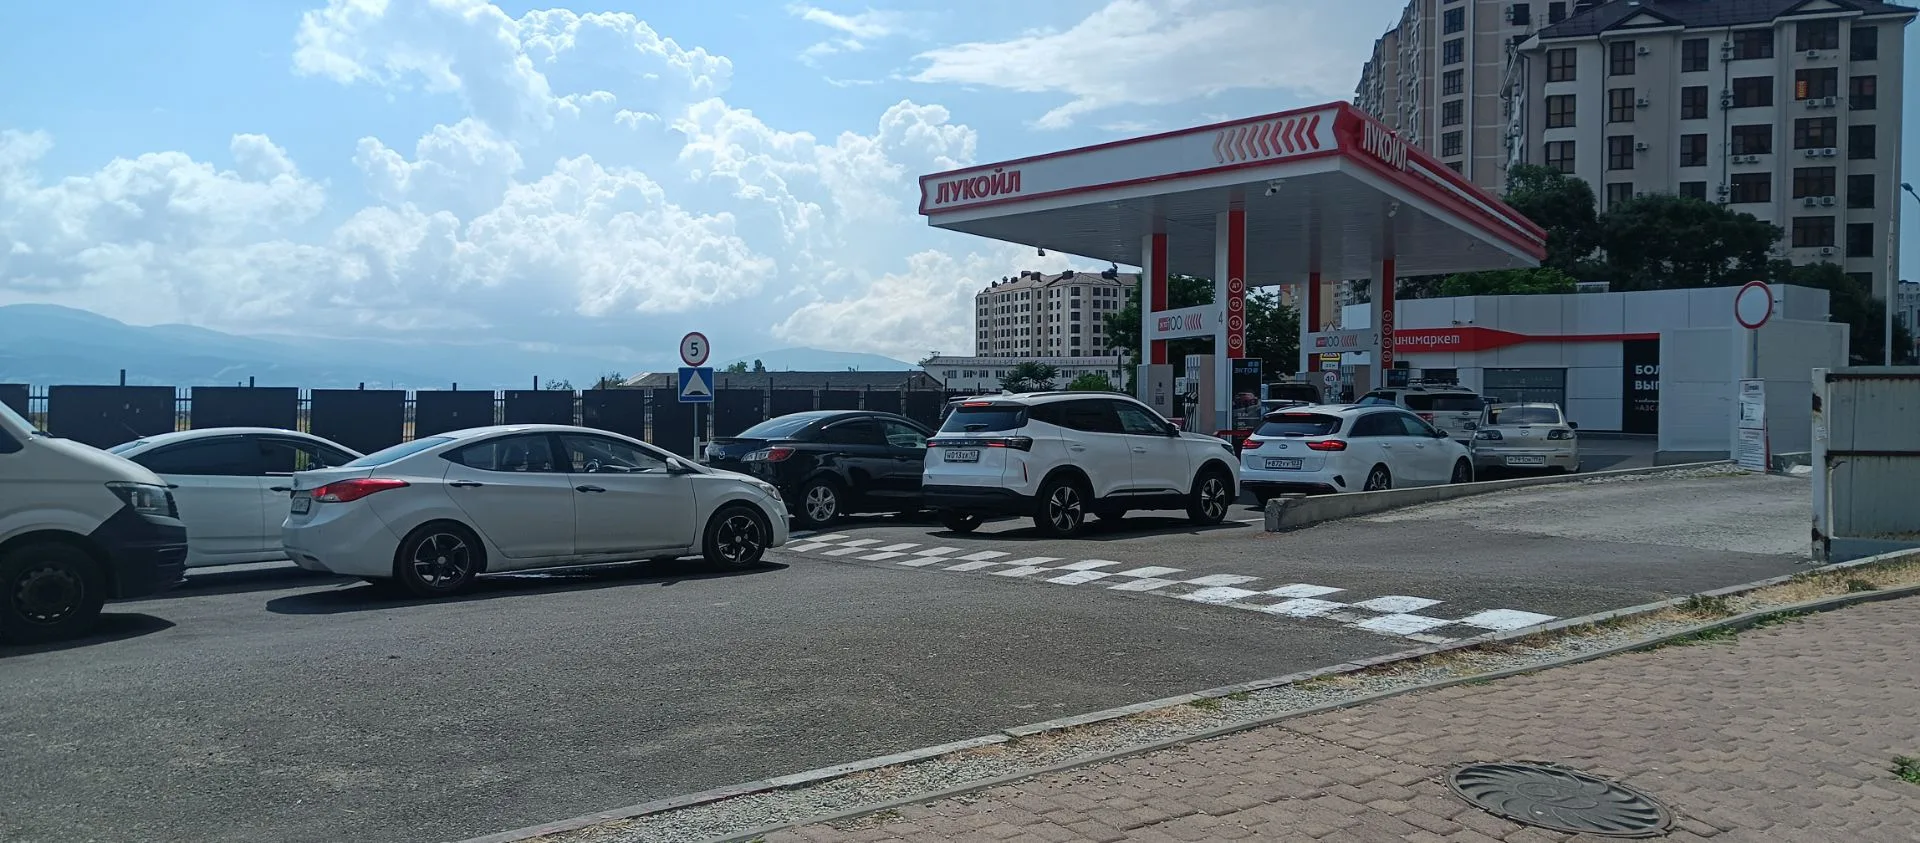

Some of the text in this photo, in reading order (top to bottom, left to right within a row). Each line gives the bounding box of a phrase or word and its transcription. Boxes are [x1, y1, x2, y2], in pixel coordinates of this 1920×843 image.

[1362, 119, 1407, 172] ЛУКОЙЛ
[935, 167, 1021, 204] ЛУКОЙЛ
[1218, 311, 1224, 325] 4
[1373, 333, 1379, 345] 2
[690, 342, 699, 357] 5
